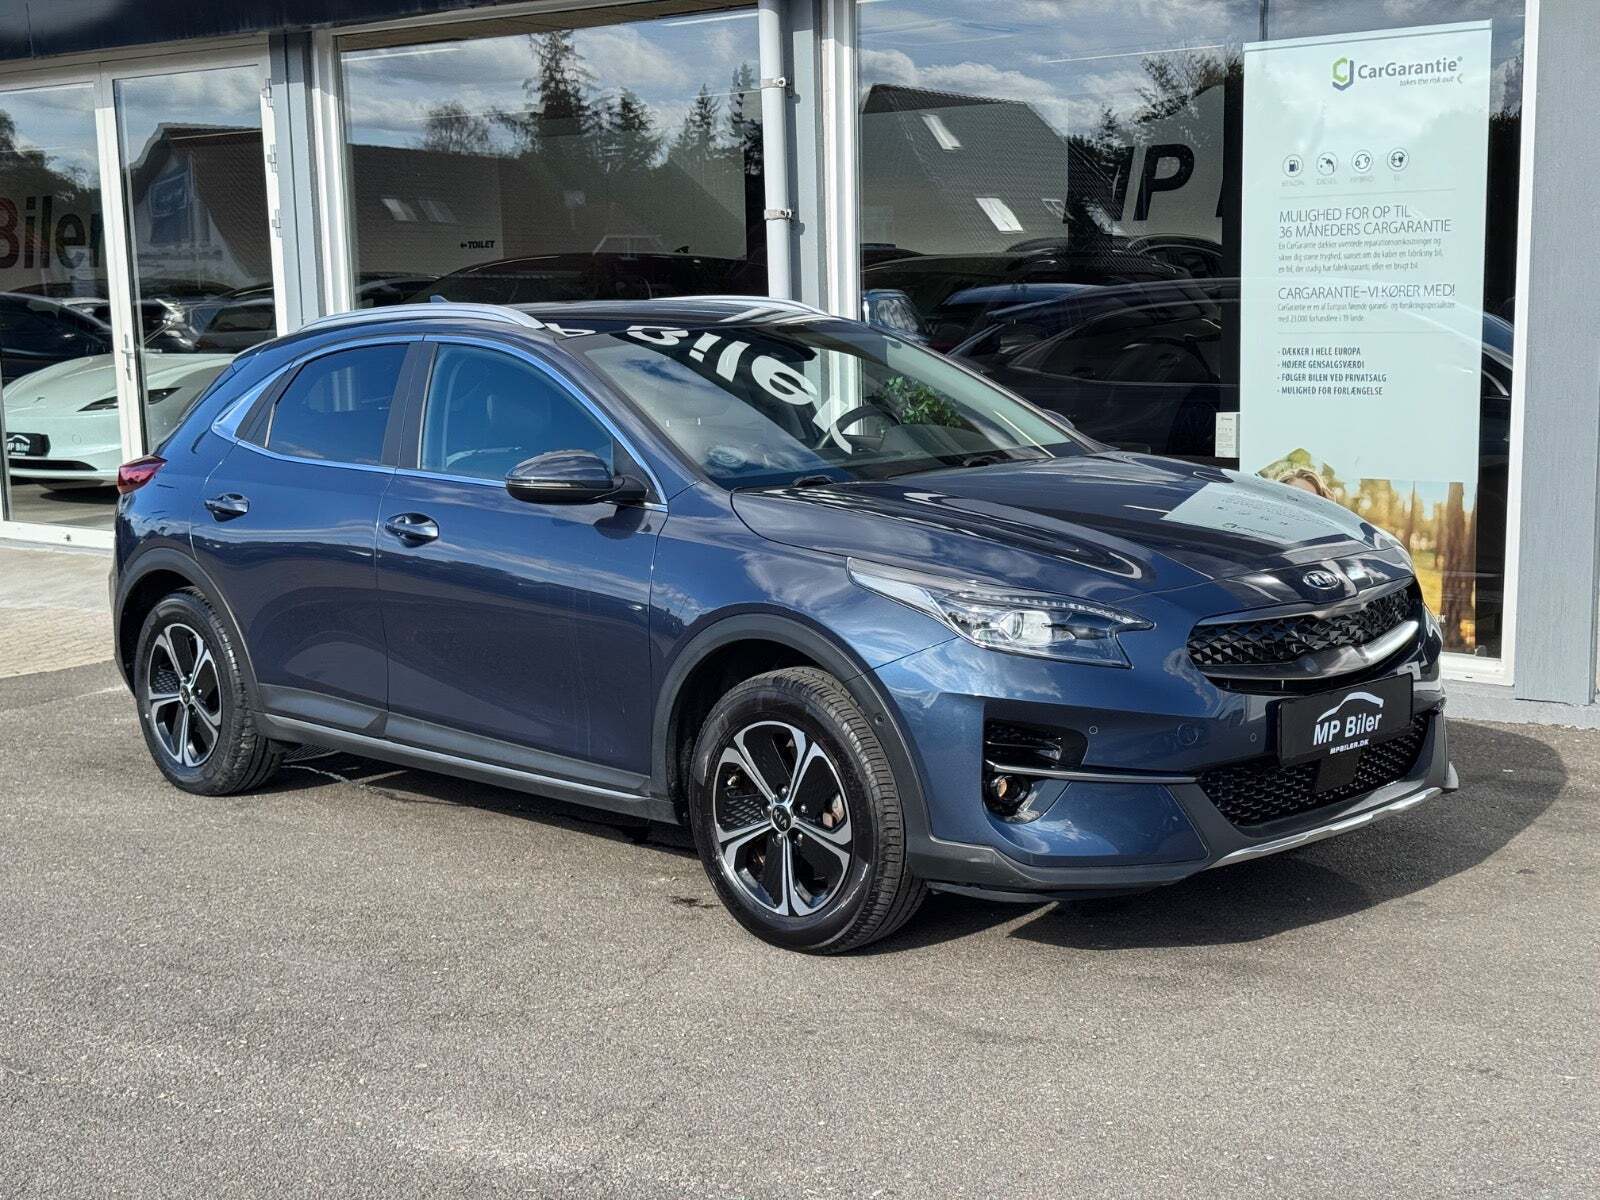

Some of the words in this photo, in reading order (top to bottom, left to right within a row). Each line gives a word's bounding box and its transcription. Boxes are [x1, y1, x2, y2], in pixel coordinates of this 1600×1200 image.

[1358, 57, 1458, 79] CarGarantie
[1279, 208, 1342, 223] MULIGHED
[1345, 206, 1369, 220] FOR
[1372, 205, 1391, 219] OP
[1395, 205, 1412, 218] TIL
[1279, 226, 1293, 238] 36
[1296, 222, 1361, 238] MÅNEDERS
[1363, 219, 1452, 235] CARGARANTIE
[467, 240, 495, 248] TOILET
[1381, 284, 1420, 298] KØRER
[1423, 283, 1456, 297] MED!
[1282, 347, 1310, 356] DÆKKER
[1316, 347, 1333, 356] HELE
[1334, 347, 1361, 356] EUROPA
[1282, 360, 1306, 369] HØJERE
[1308, 360, 1365, 369] GENSALGSVÆRDI
[1282, 373, 1306, 382] FØLGER
[1309, 373, 1328, 382] BILEN
[1330, 373, 1344, 382] VED
[1345, 373, 1387, 382] PRIVATSALG
[1282, 386, 1317, 395] MULIGHED
[1318, 386, 1332, 395] FOR
[1333, 386, 1383, 396] FORLÆNGELSE
[1313, 720, 1341, 746] MP
[1344, 712, 1382, 738] Biler
[1329, 739, 1369, 755] MPBILER.DK
